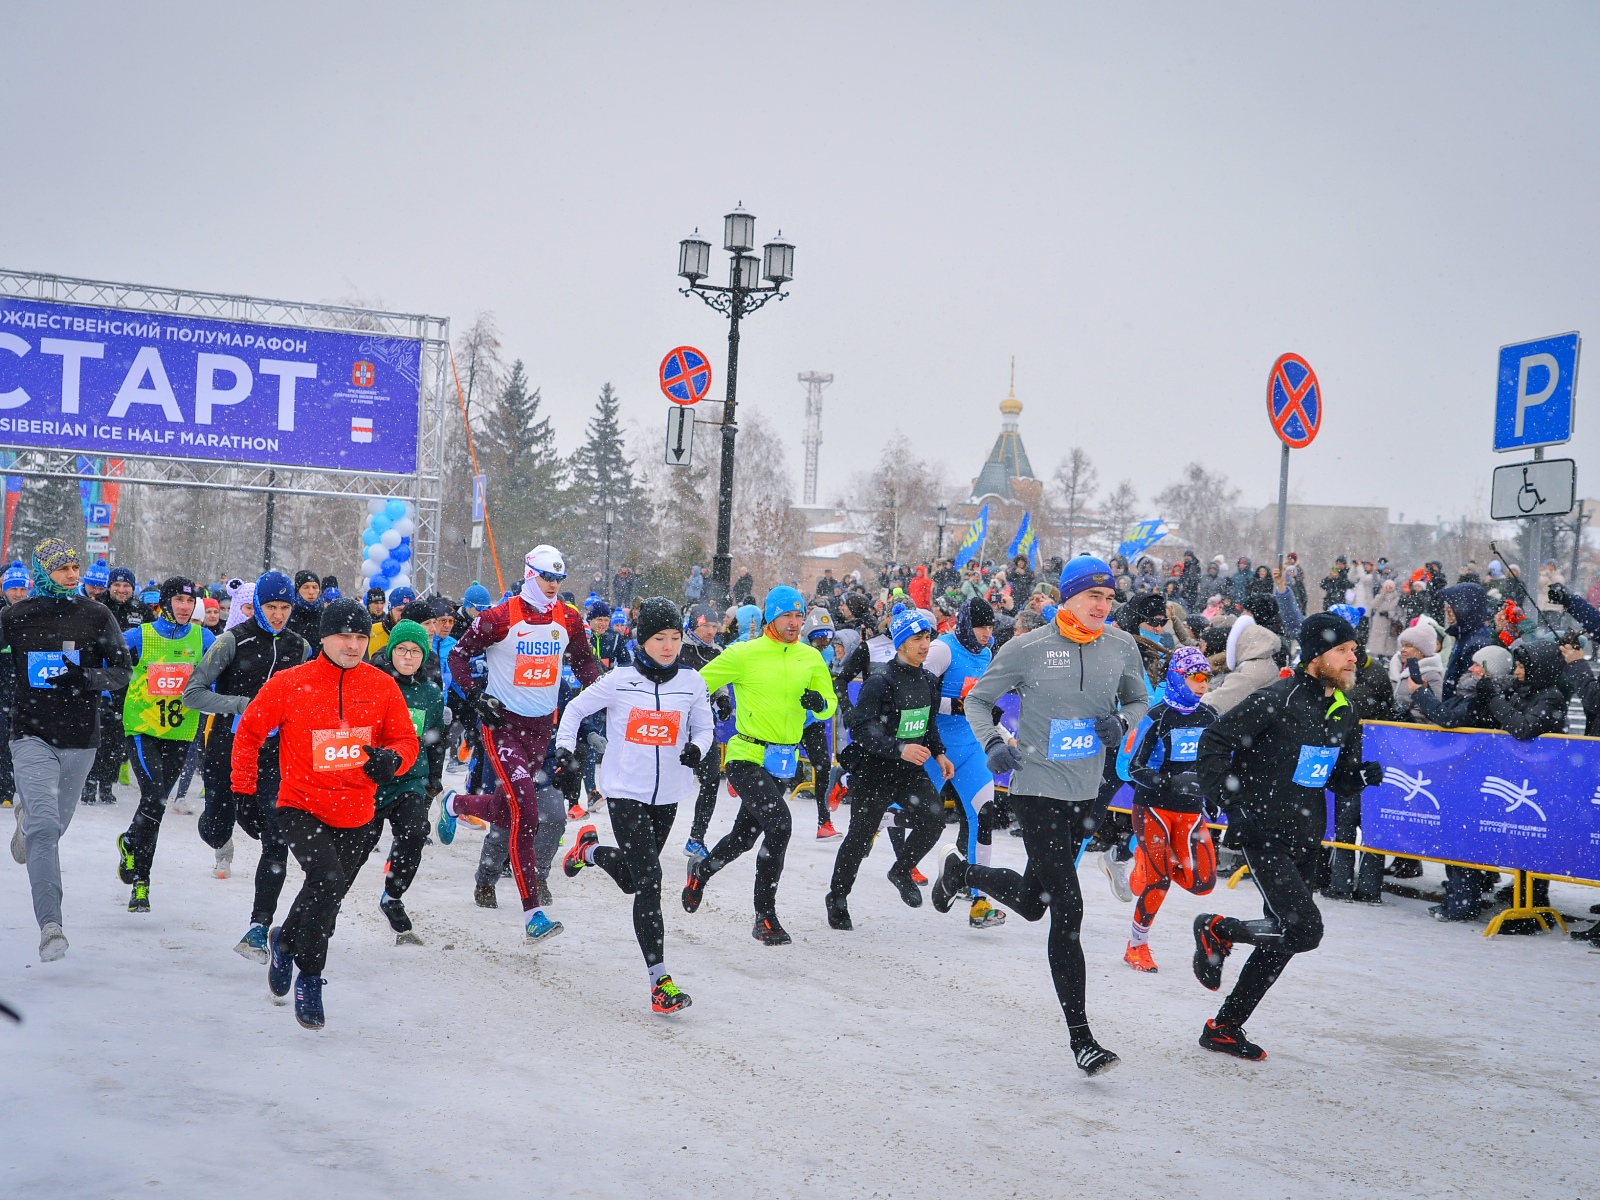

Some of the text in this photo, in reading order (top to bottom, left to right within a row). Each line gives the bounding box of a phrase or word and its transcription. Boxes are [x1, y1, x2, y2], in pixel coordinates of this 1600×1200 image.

[0, 309, 308, 353] ЖДЕСТВЕНСКИЙ ПОЛУМАРАФОН
[1513, 352, 1560, 438] P
[0, 418, 279, 452] SIBERIAN ICE HALF MARATHON
[93, 505, 107, 522] P
[516, 640, 561, 656] RUSSIA
[1046, 650, 1070, 659] IRON
[1047, 658, 1071, 666] TEAM
[522, 668, 551, 680] 454
[157, 677, 184, 689] 657
[156, 698, 184, 728] 18
[636, 724, 669, 738] 452
[904, 719, 926, 732] 1146
[1060, 734, 1094, 751] 248
[324, 744, 361, 762] 846
[1310, 763, 1329, 778] 24
